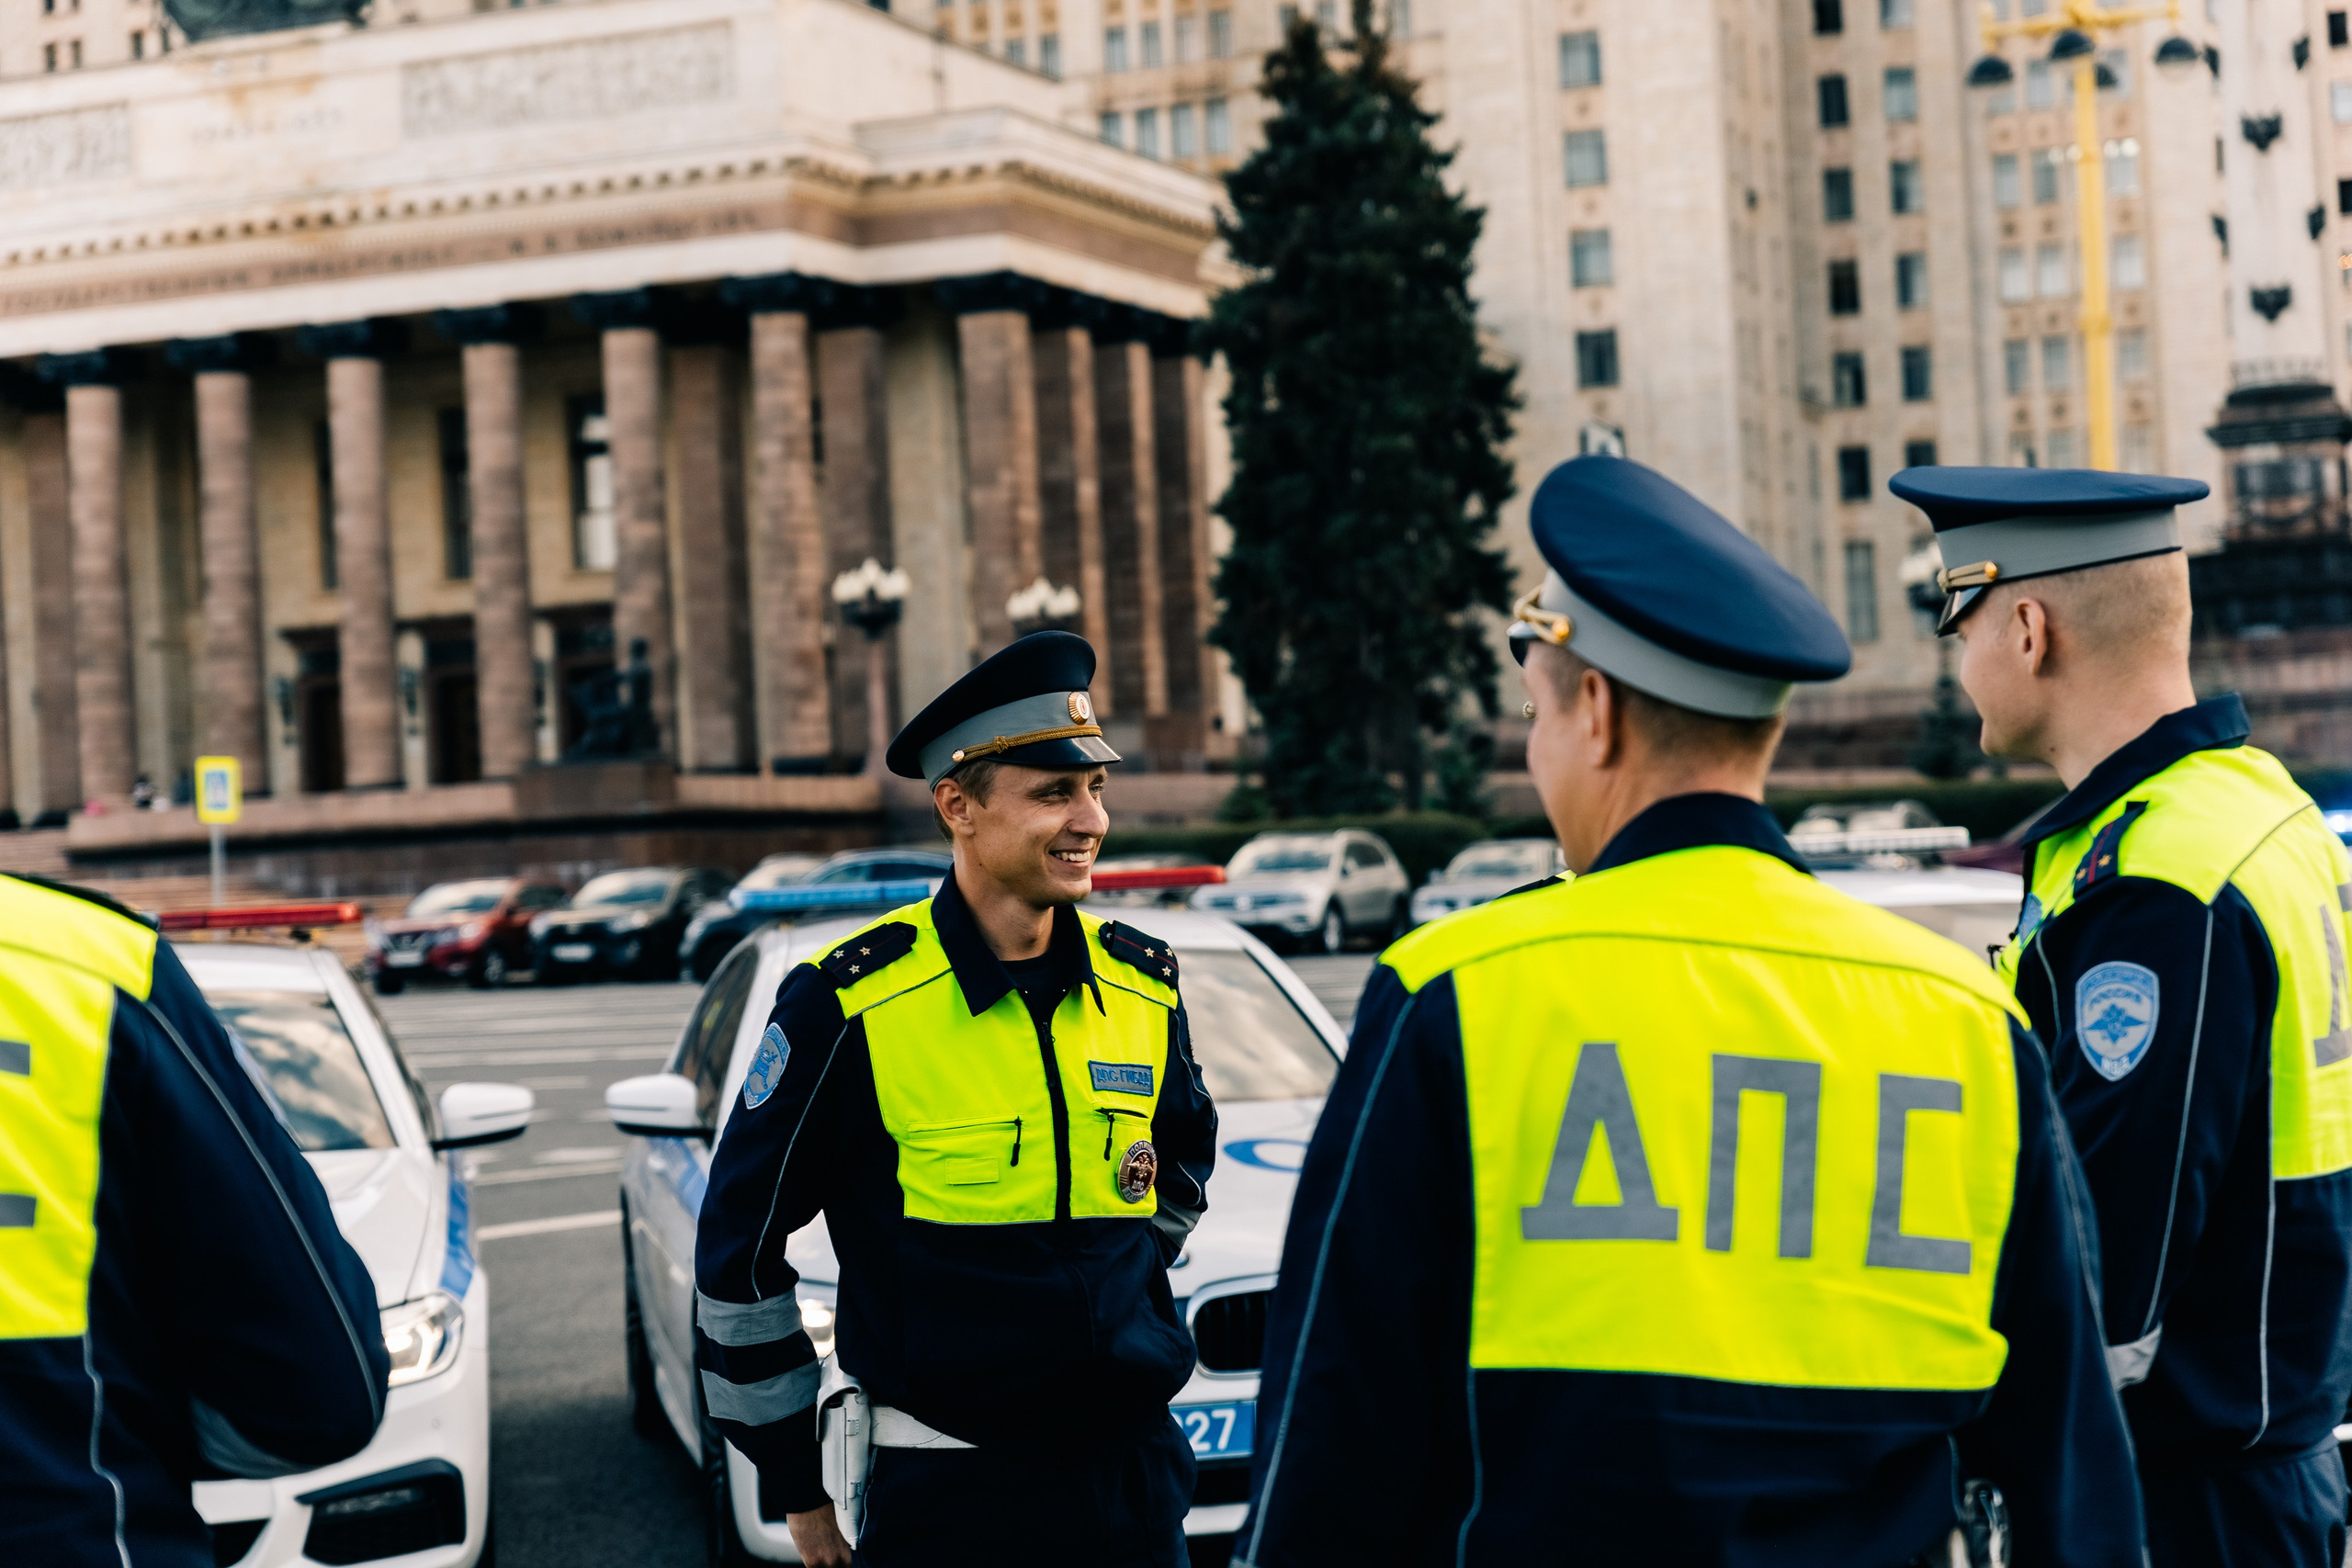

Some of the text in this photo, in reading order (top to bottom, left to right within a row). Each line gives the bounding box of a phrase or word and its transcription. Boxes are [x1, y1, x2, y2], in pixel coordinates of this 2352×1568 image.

[1095, 1067, 1150, 1087] ДПС ГИБДД
[1521, 1042, 1972, 1275] ДПС
[1171, 1408, 1237, 1452] 27
